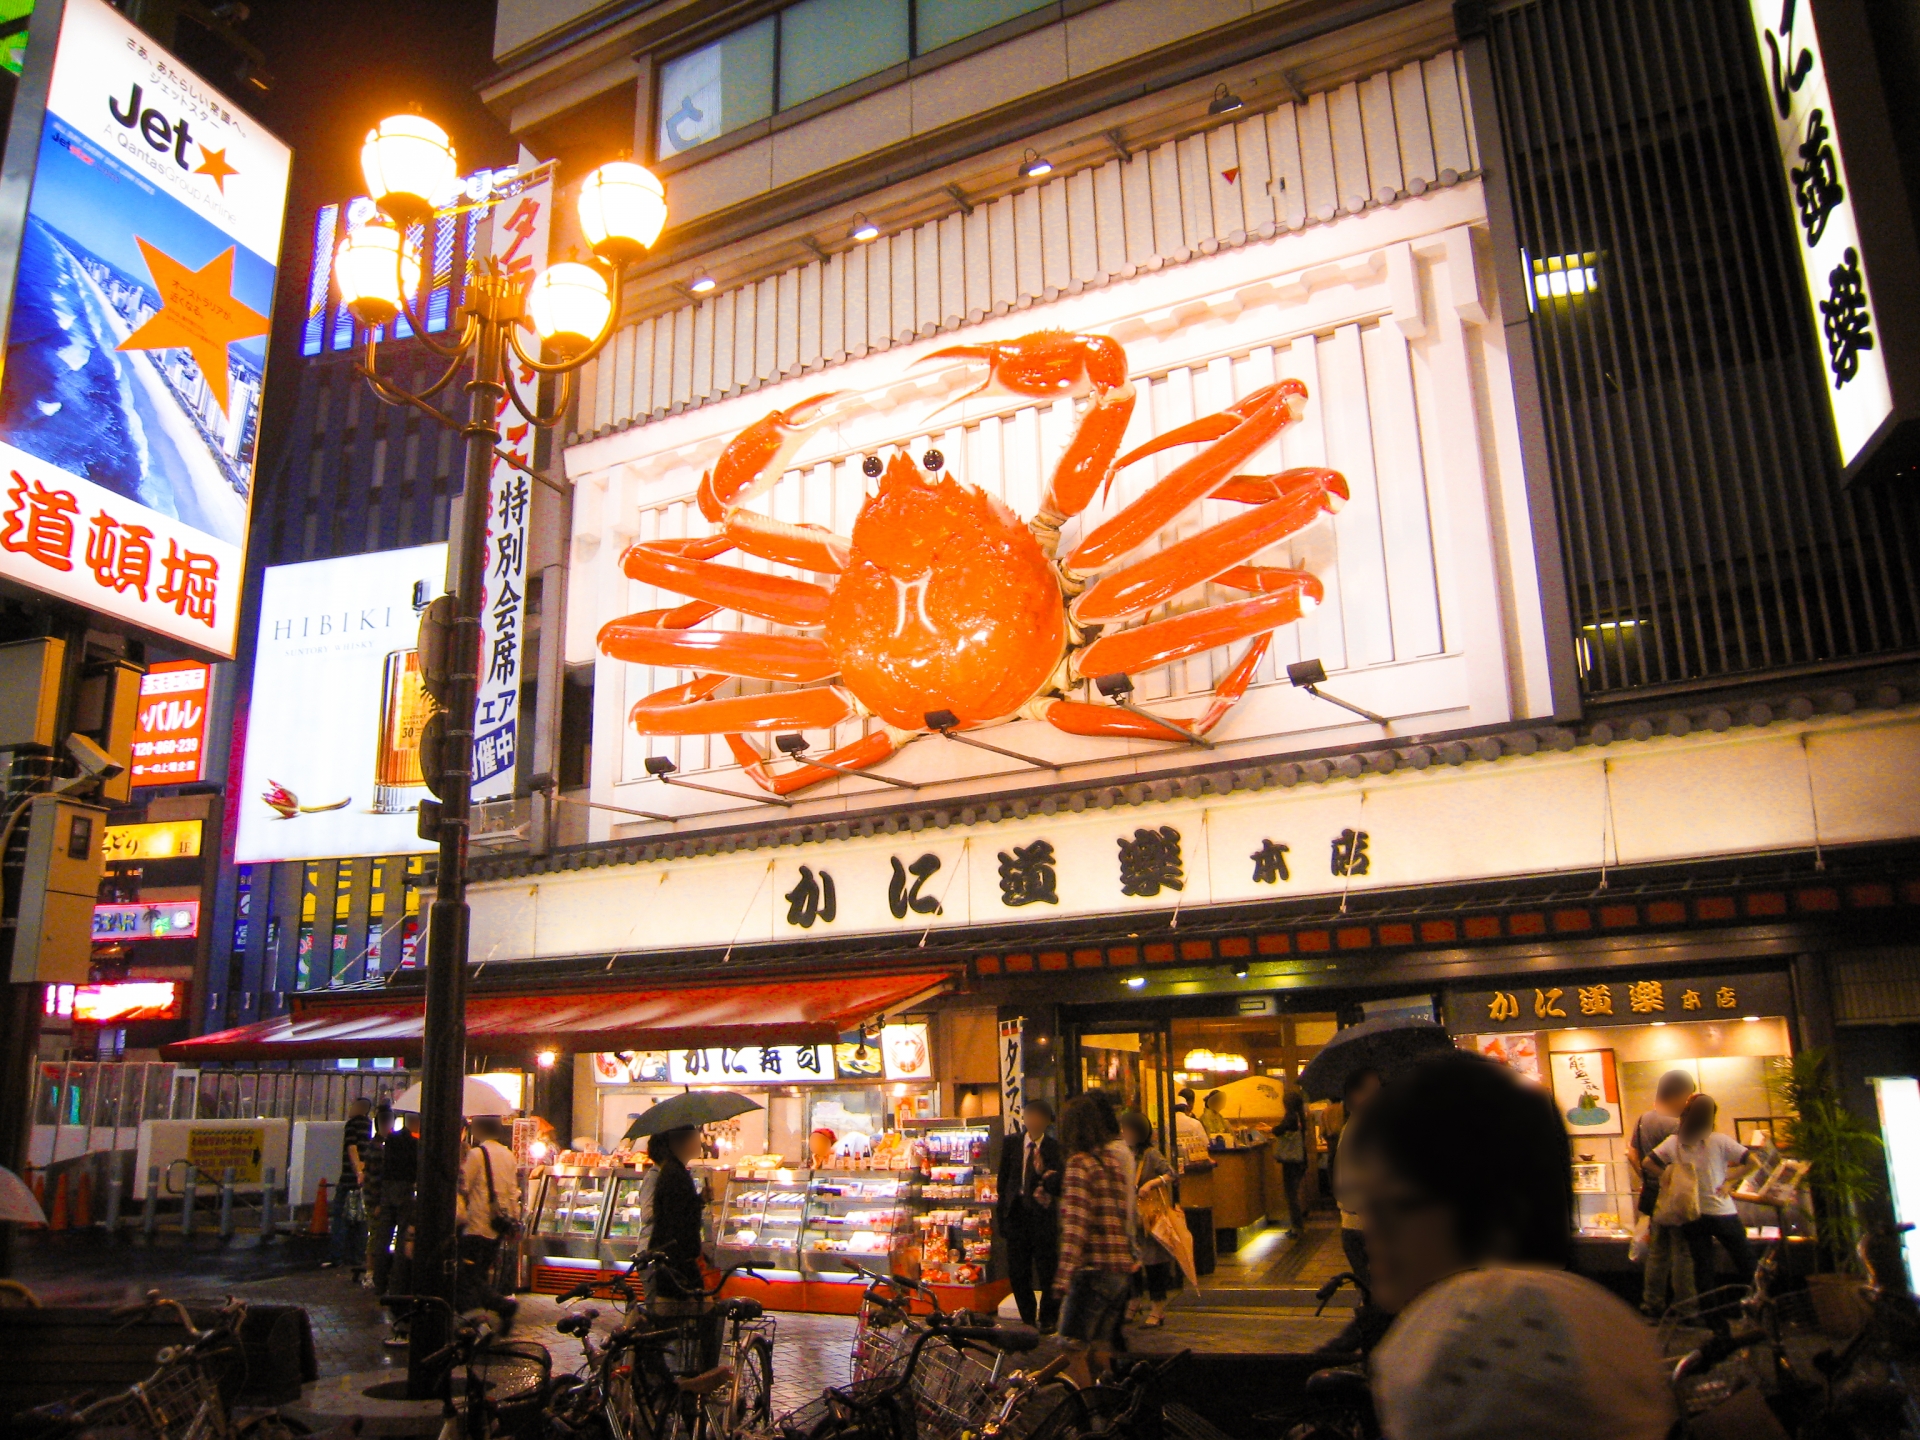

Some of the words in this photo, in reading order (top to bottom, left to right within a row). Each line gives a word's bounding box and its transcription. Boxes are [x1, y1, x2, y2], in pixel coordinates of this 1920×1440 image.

[109, 82, 193, 171] Jet
[0, 469, 219, 628] 道頓堀
[273, 606, 392, 641] HIBIKI
[334, 640, 375, 652] WHISKY
[402, 727, 415, 739] 30
[131, 738, 198, 756] 120-860-239
